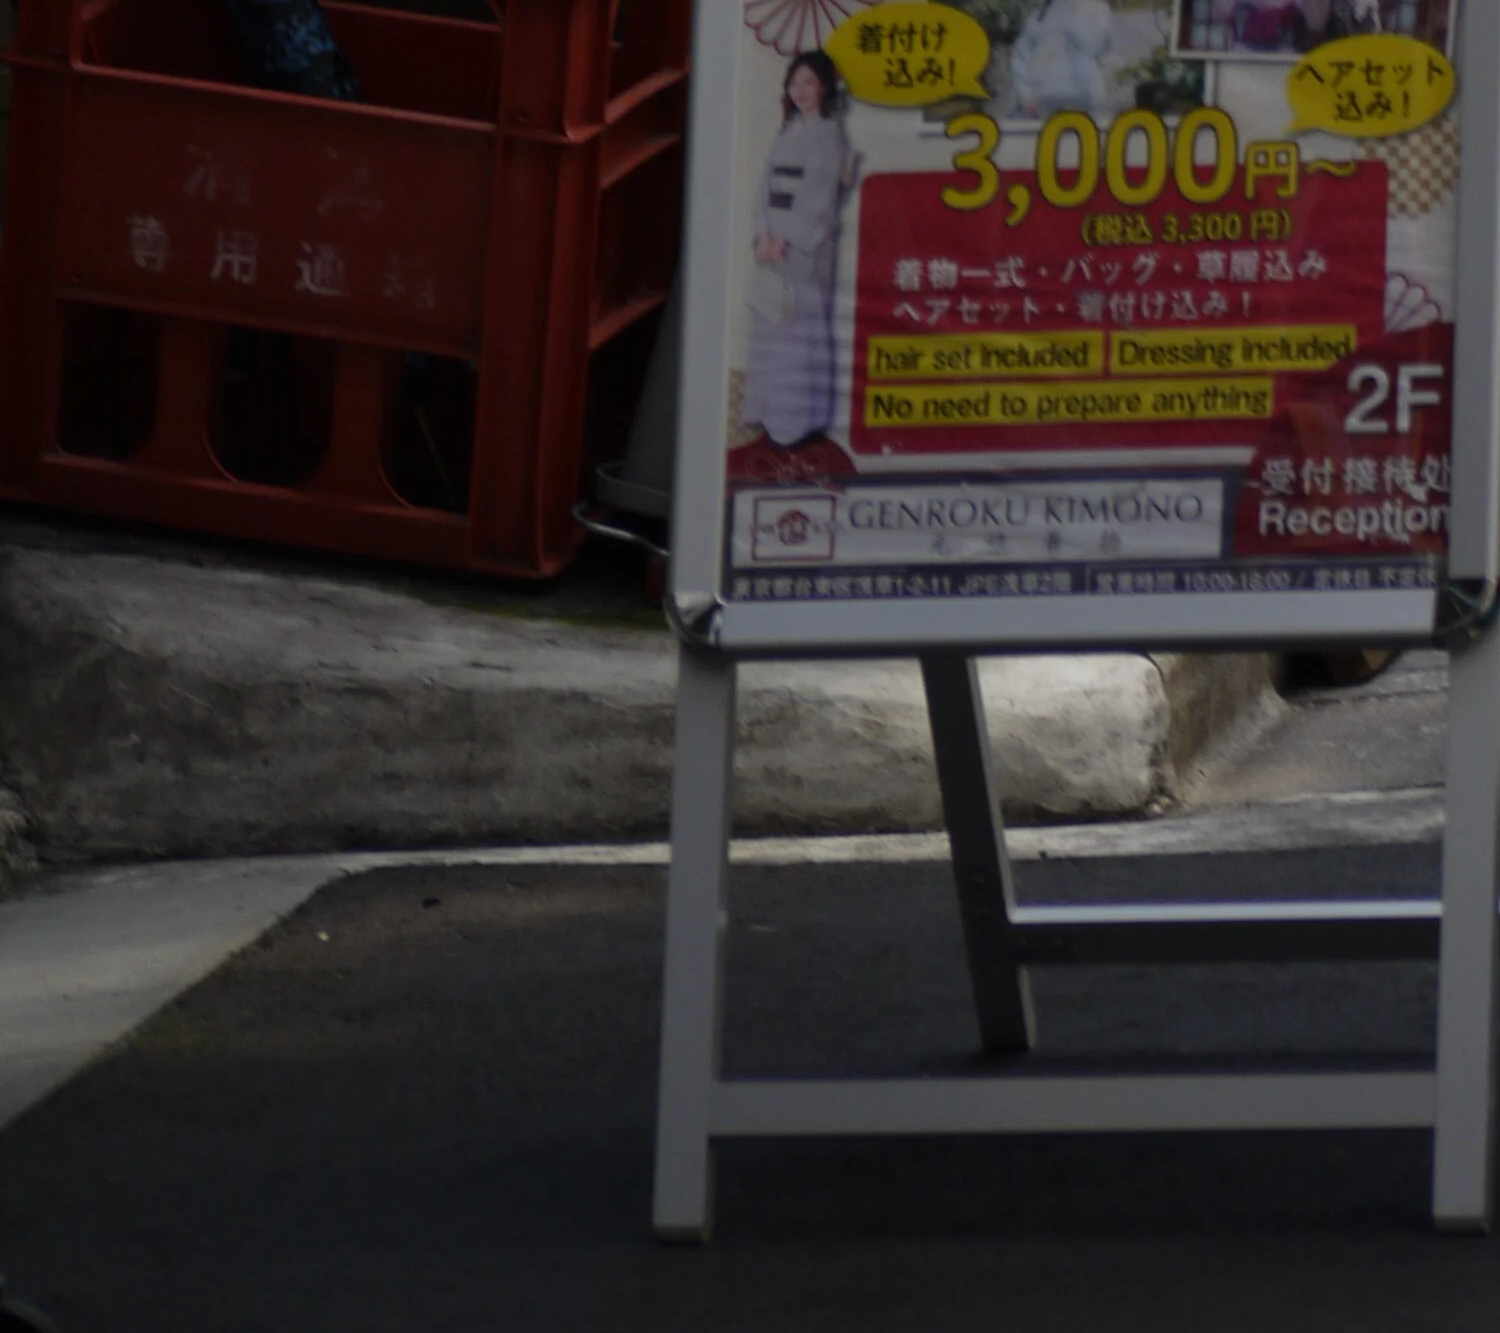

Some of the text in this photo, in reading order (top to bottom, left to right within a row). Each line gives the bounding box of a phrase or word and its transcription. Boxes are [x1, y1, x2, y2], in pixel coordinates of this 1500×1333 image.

[857, 21, 949, 55] 着付け
[1295, 56, 1444, 87] ヘアセット
[1161, 213, 1243, 245] 3,300
[875, 344, 926, 374] hair
[932, 344, 973, 371] set
[1118, 337, 1233, 369] Dressing
[872, 386, 1268, 421] No need to prepare anything
[1343, 362, 1445, 434] 2F
[848, 496, 1029, 530] GENROKU
[1045, 492, 1204, 527] KIMONO
